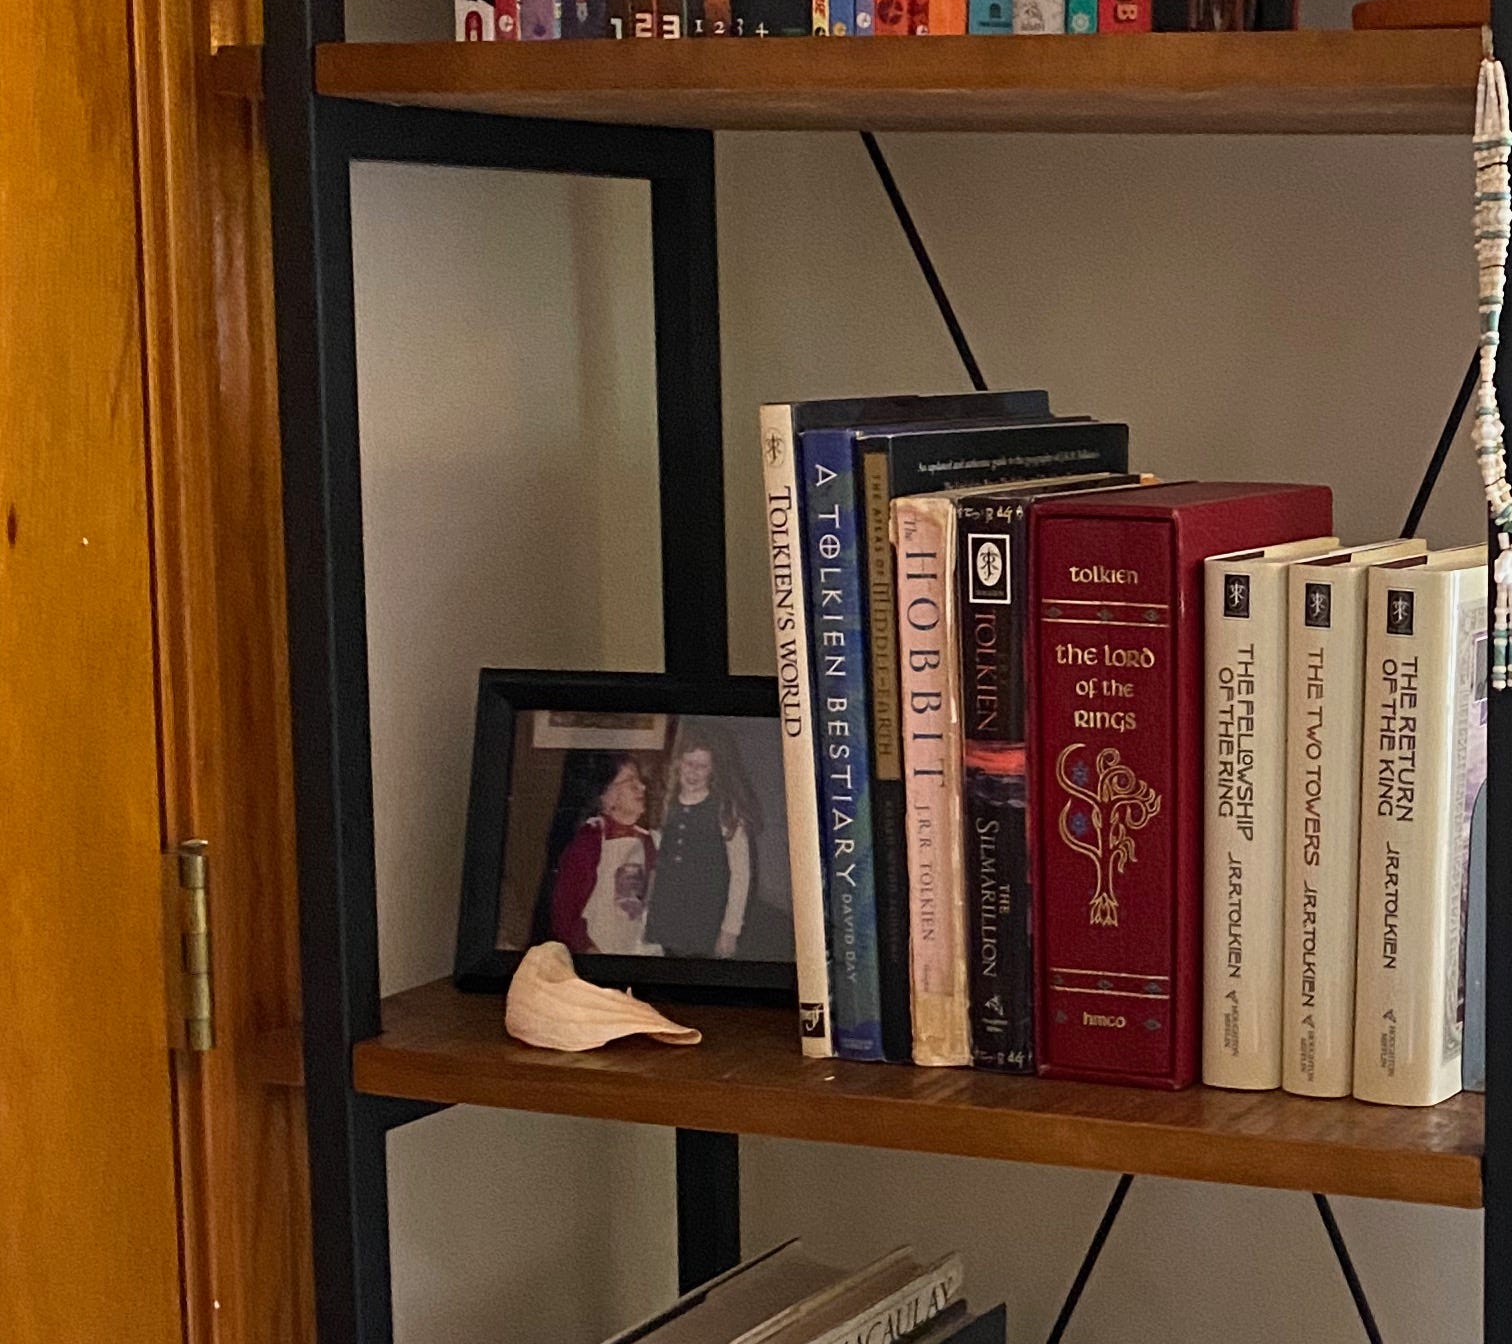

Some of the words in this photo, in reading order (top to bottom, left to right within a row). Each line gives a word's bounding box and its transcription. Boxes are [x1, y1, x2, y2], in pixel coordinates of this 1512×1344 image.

[815, 463, 838, 488] A
[873, 474, 881, 499] THE
[873, 506, 885, 553] ATLAS
[903, 520, 918, 542] The
[768, 485, 796, 632] TOLKIEN'S
[818, 503, 847, 678] TOLKIEN
[872, 582, 894, 756] MIDDLE-EARTH
[905, 551, 945, 787] HOBBIT
[975, 613, 998, 731] TOLKIEN
[1055, 643, 1098, 666] the
[1237, 642, 1254, 696] THE
[1307, 647, 1324, 700] THE
[1382, 659, 1398, 695] OF
[778, 640, 802, 738] WORLD
[1075, 677, 1098, 699] of
[1101, 679, 1135, 698] the
[1218, 666, 1234, 701] OF
[1400, 656, 1419, 710] THE
[1218, 704, 1234, 756] THE
[1305, 706, 1323, 760] TWO
[1380, 697, 1397, 751] THE
[826, 696, 857, 888] BESTIARY
[1217, 760, 1234, 818] RING
[1236, 699, 1254, 841] FELLOWSHIP
[1377, 758, 1395, 817] KING
[1396, 716, 1417, 822] RETURN
[1303, 765, 1322, 867] TOWERS
[840, 894, 855, 945] DAVID
[920, 862, 935, 942] TOLKIEN
[975, 817, 999, 978] SILMARILLION
[1000, 883, 1010, 914] THE
[845, 949, 858, 984] DAY
